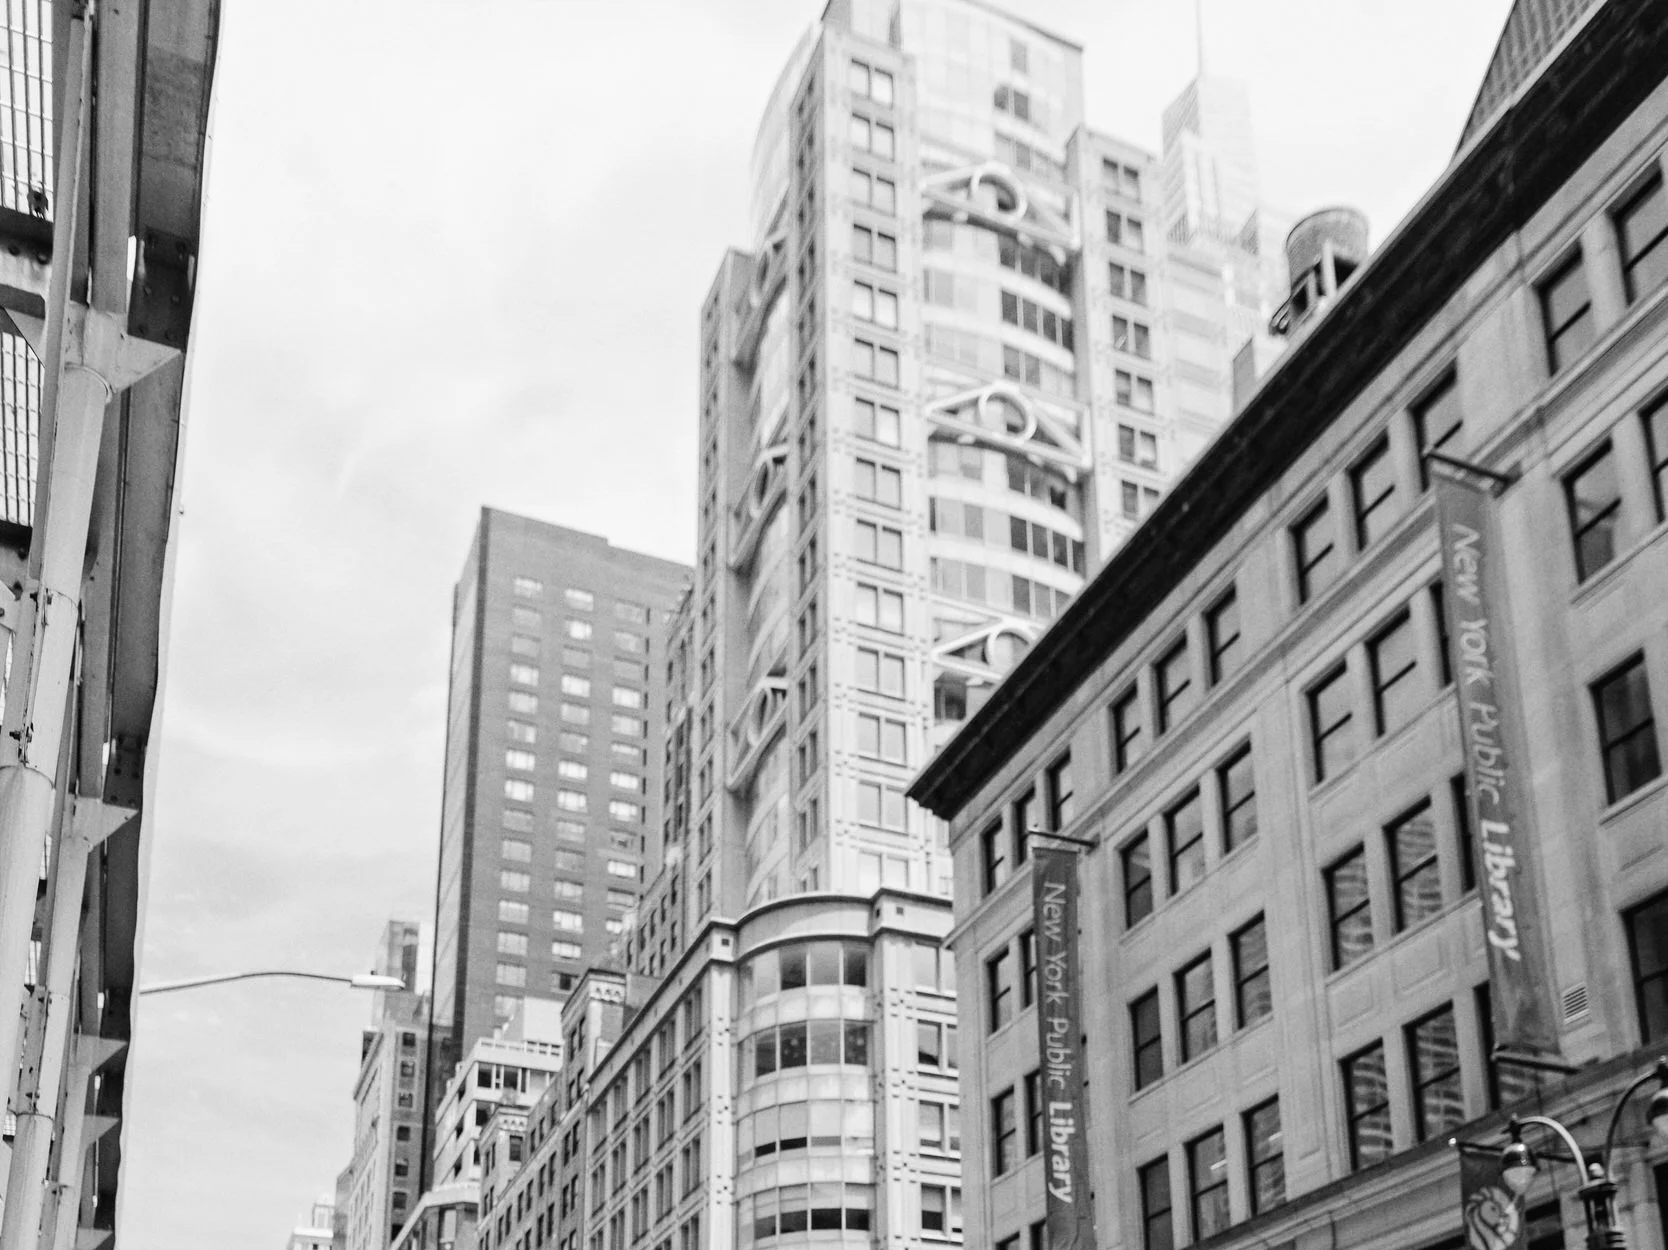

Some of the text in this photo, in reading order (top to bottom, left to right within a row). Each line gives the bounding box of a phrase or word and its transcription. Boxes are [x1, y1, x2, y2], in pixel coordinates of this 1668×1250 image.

[1452, 522, 1522, 961] New York Public Library
[1043, 881, 1076, 1203] New York Public Library
